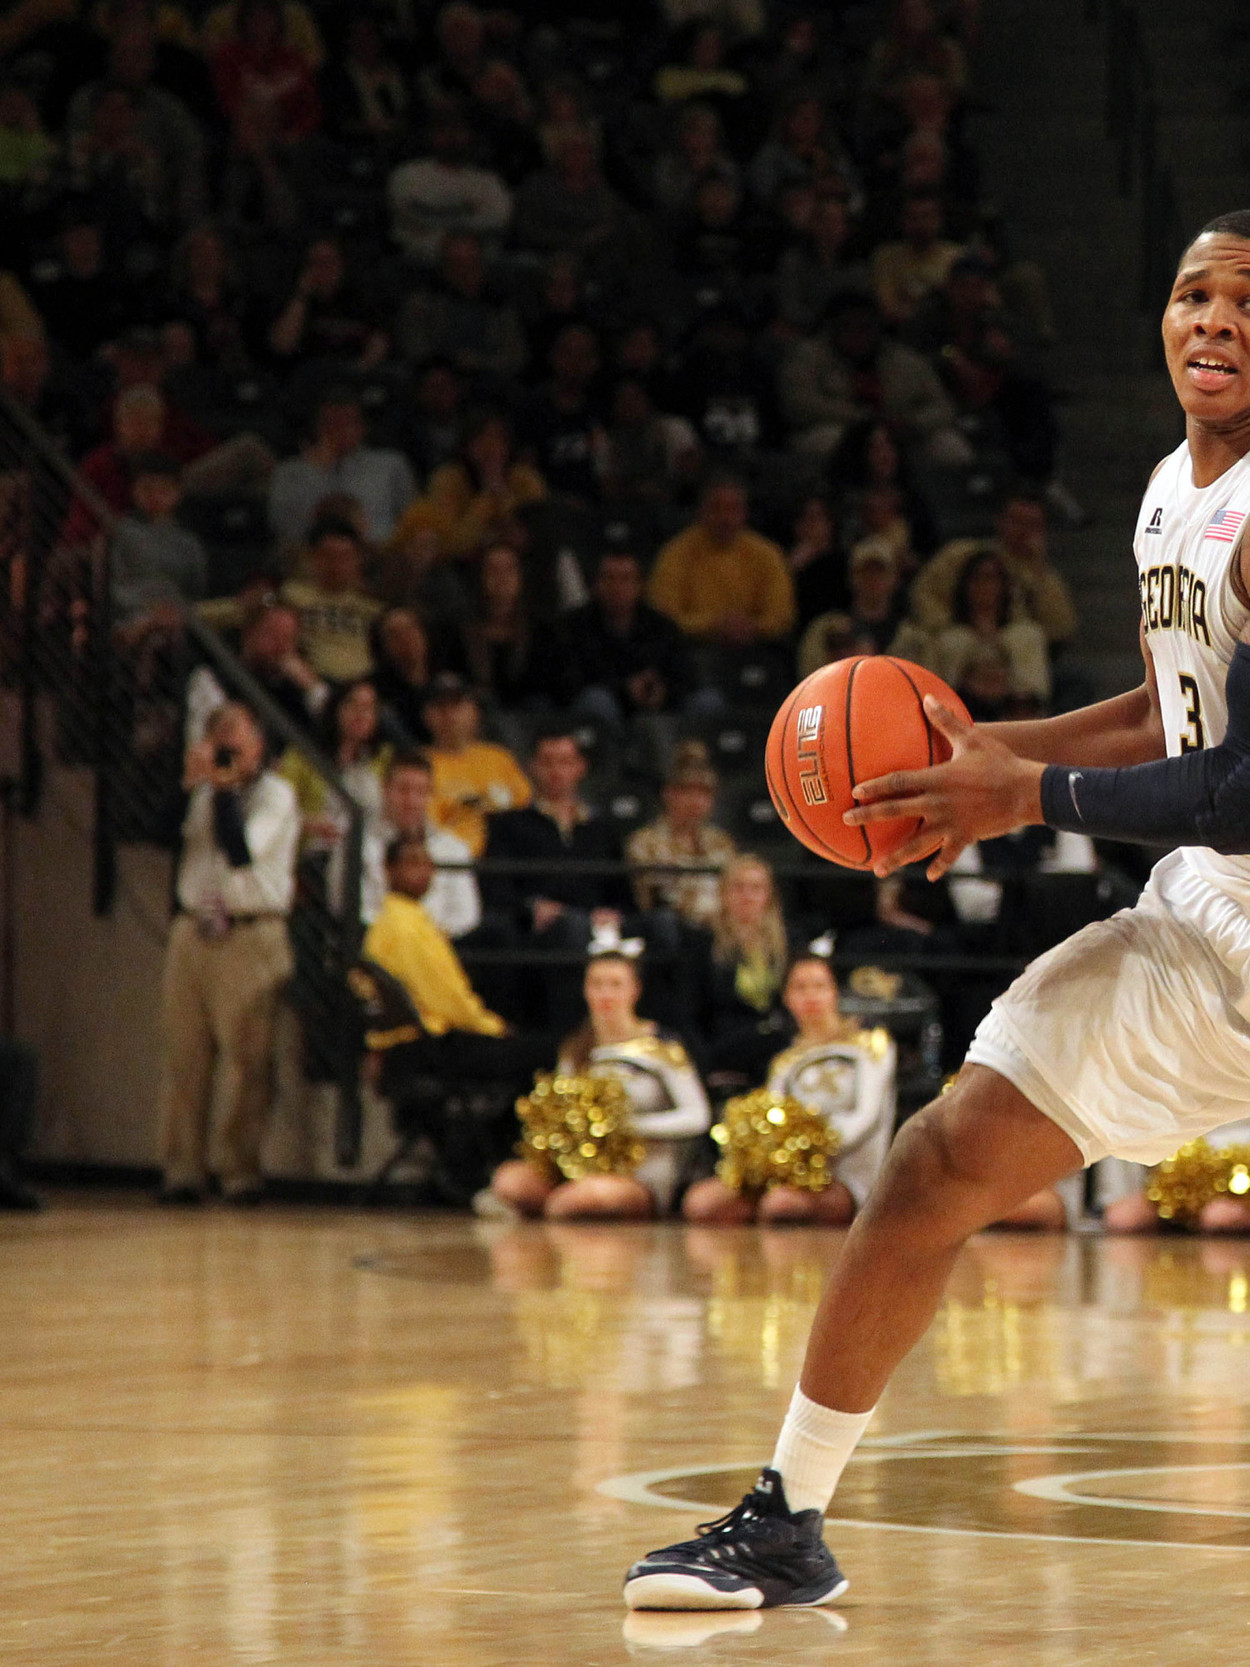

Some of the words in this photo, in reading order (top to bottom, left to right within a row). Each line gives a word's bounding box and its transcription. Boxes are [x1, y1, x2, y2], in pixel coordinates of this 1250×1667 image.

[1139, 563, 1212, 648] GEOIA
[1179, 670, 1205, 753] 3
[797, 705, 828, 807] ELITE
